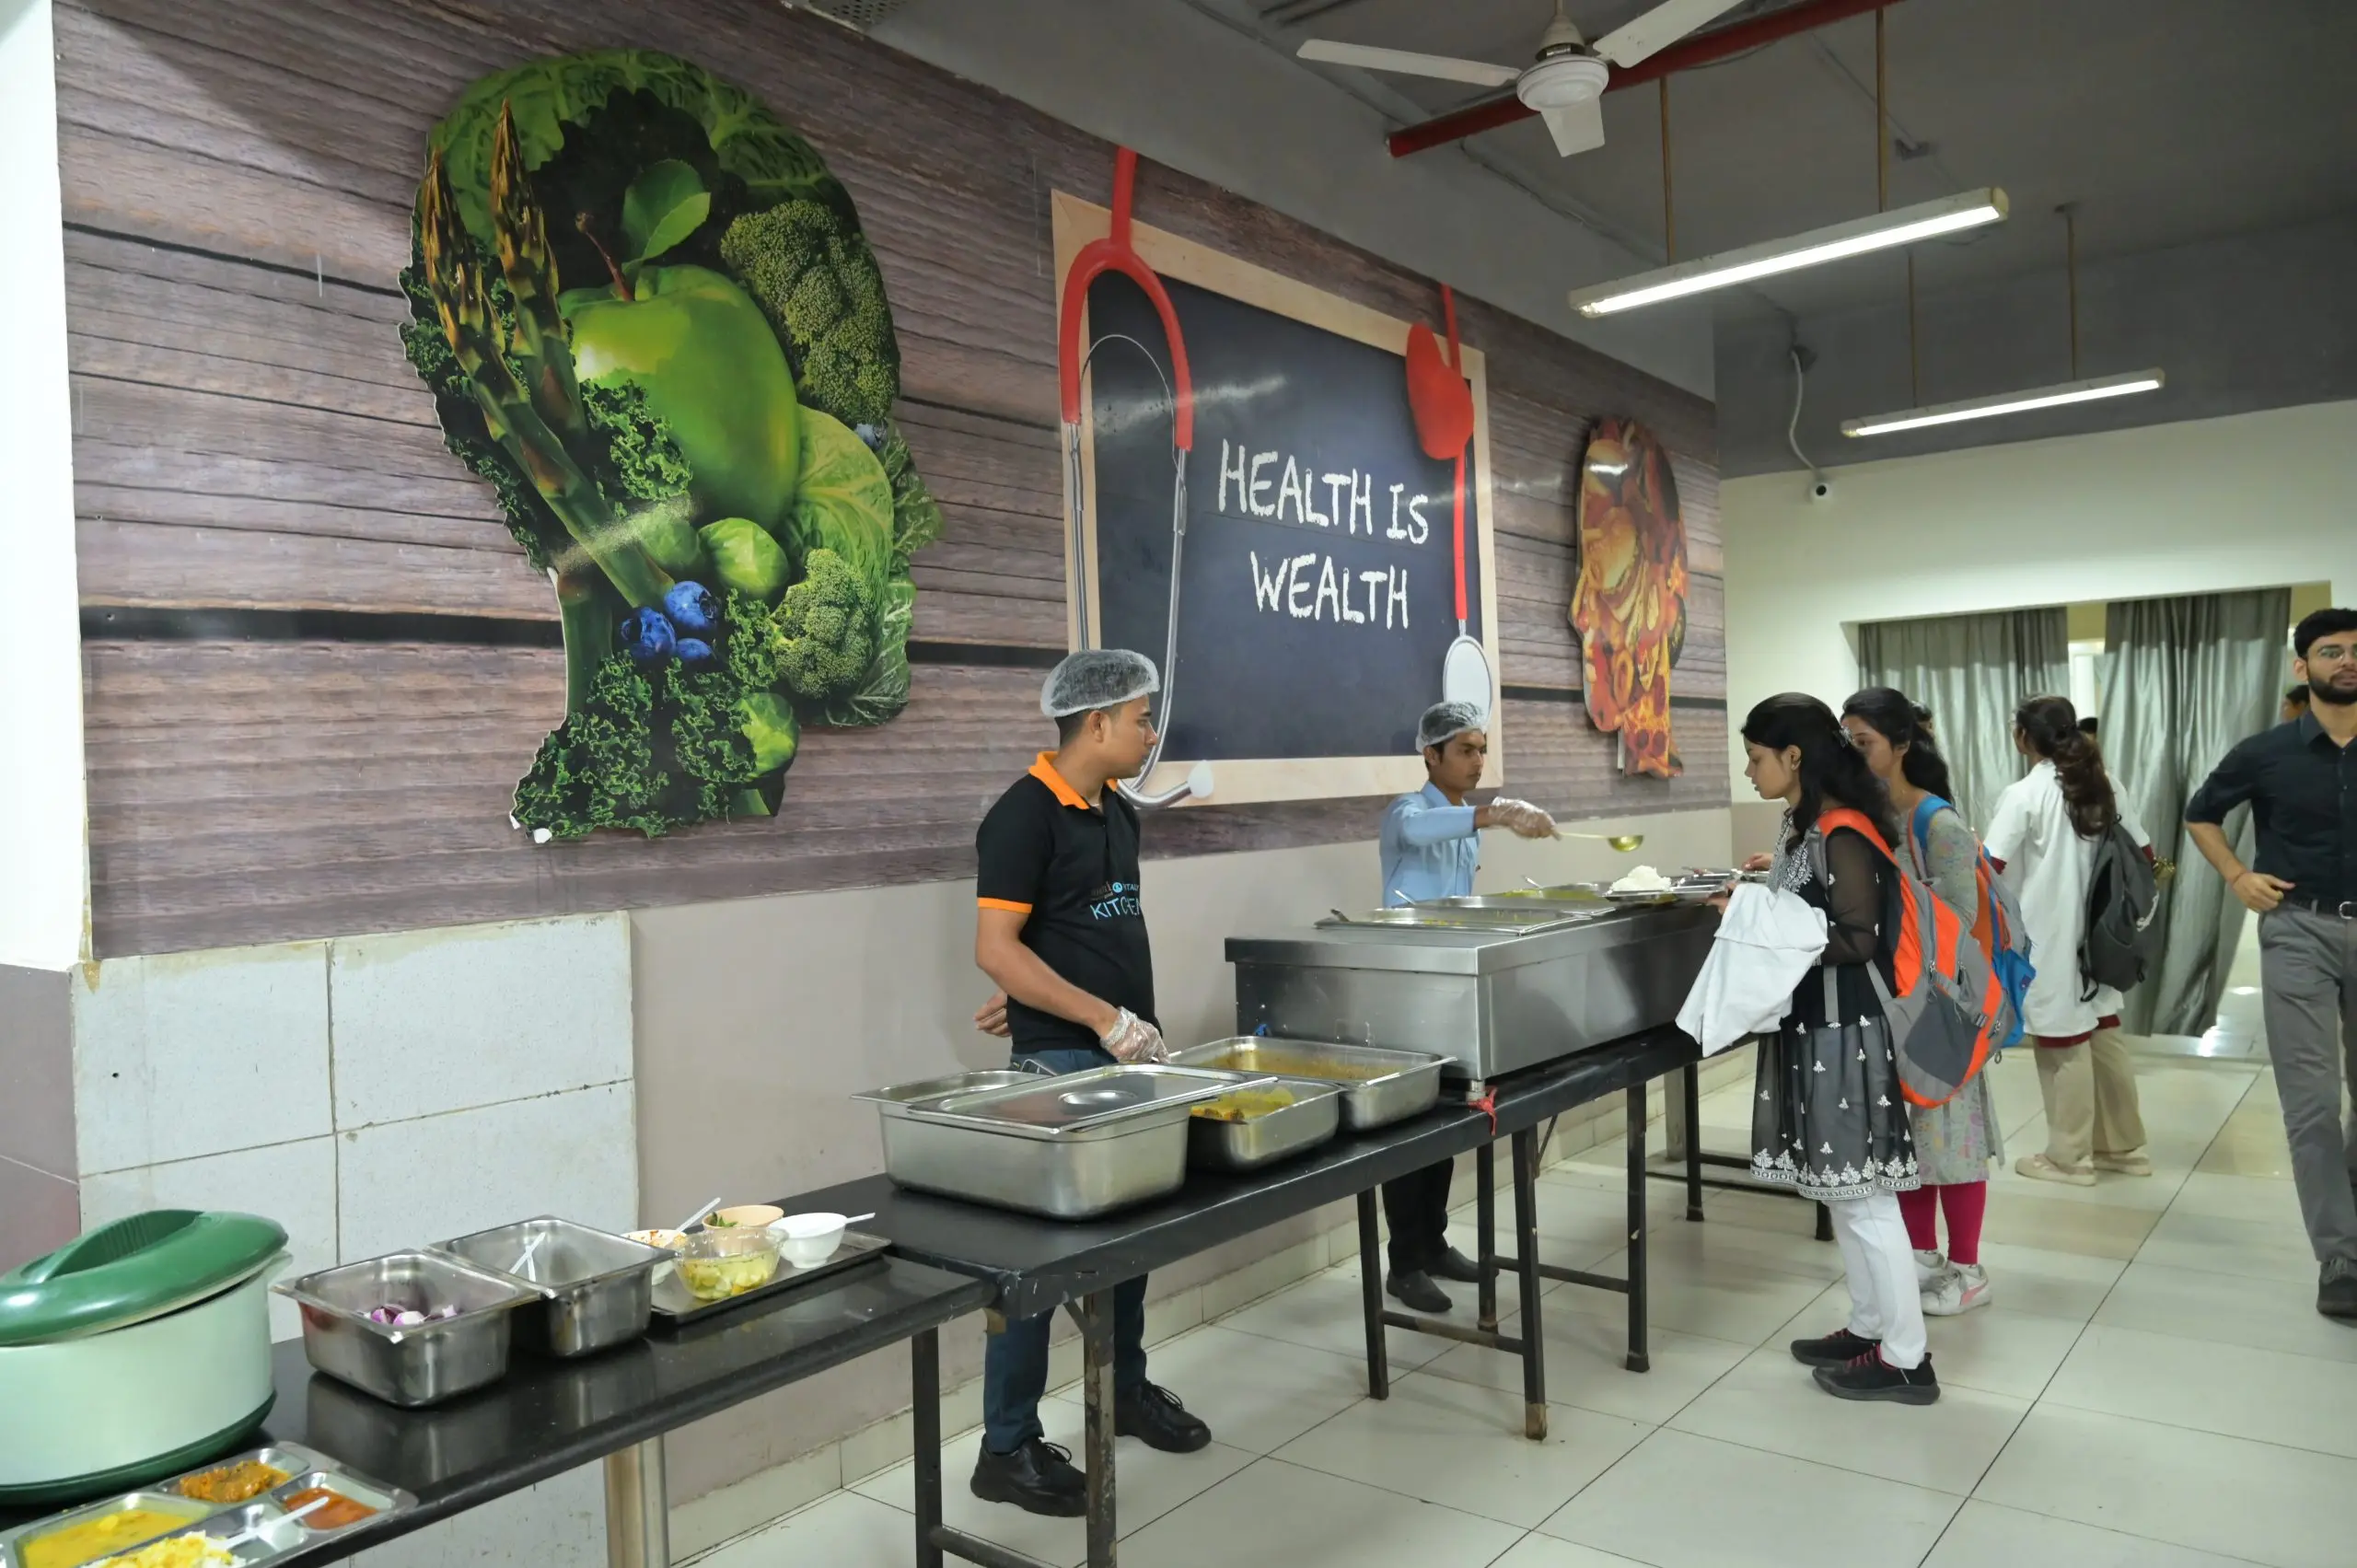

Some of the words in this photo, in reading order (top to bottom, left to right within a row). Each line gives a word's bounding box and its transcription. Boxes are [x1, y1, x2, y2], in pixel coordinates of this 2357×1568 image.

[1218, 438, 1373, 535] HEALTH
[1386, 483, 1428, 544] IS
[1250, 551, 1409, 630] WEALTH
